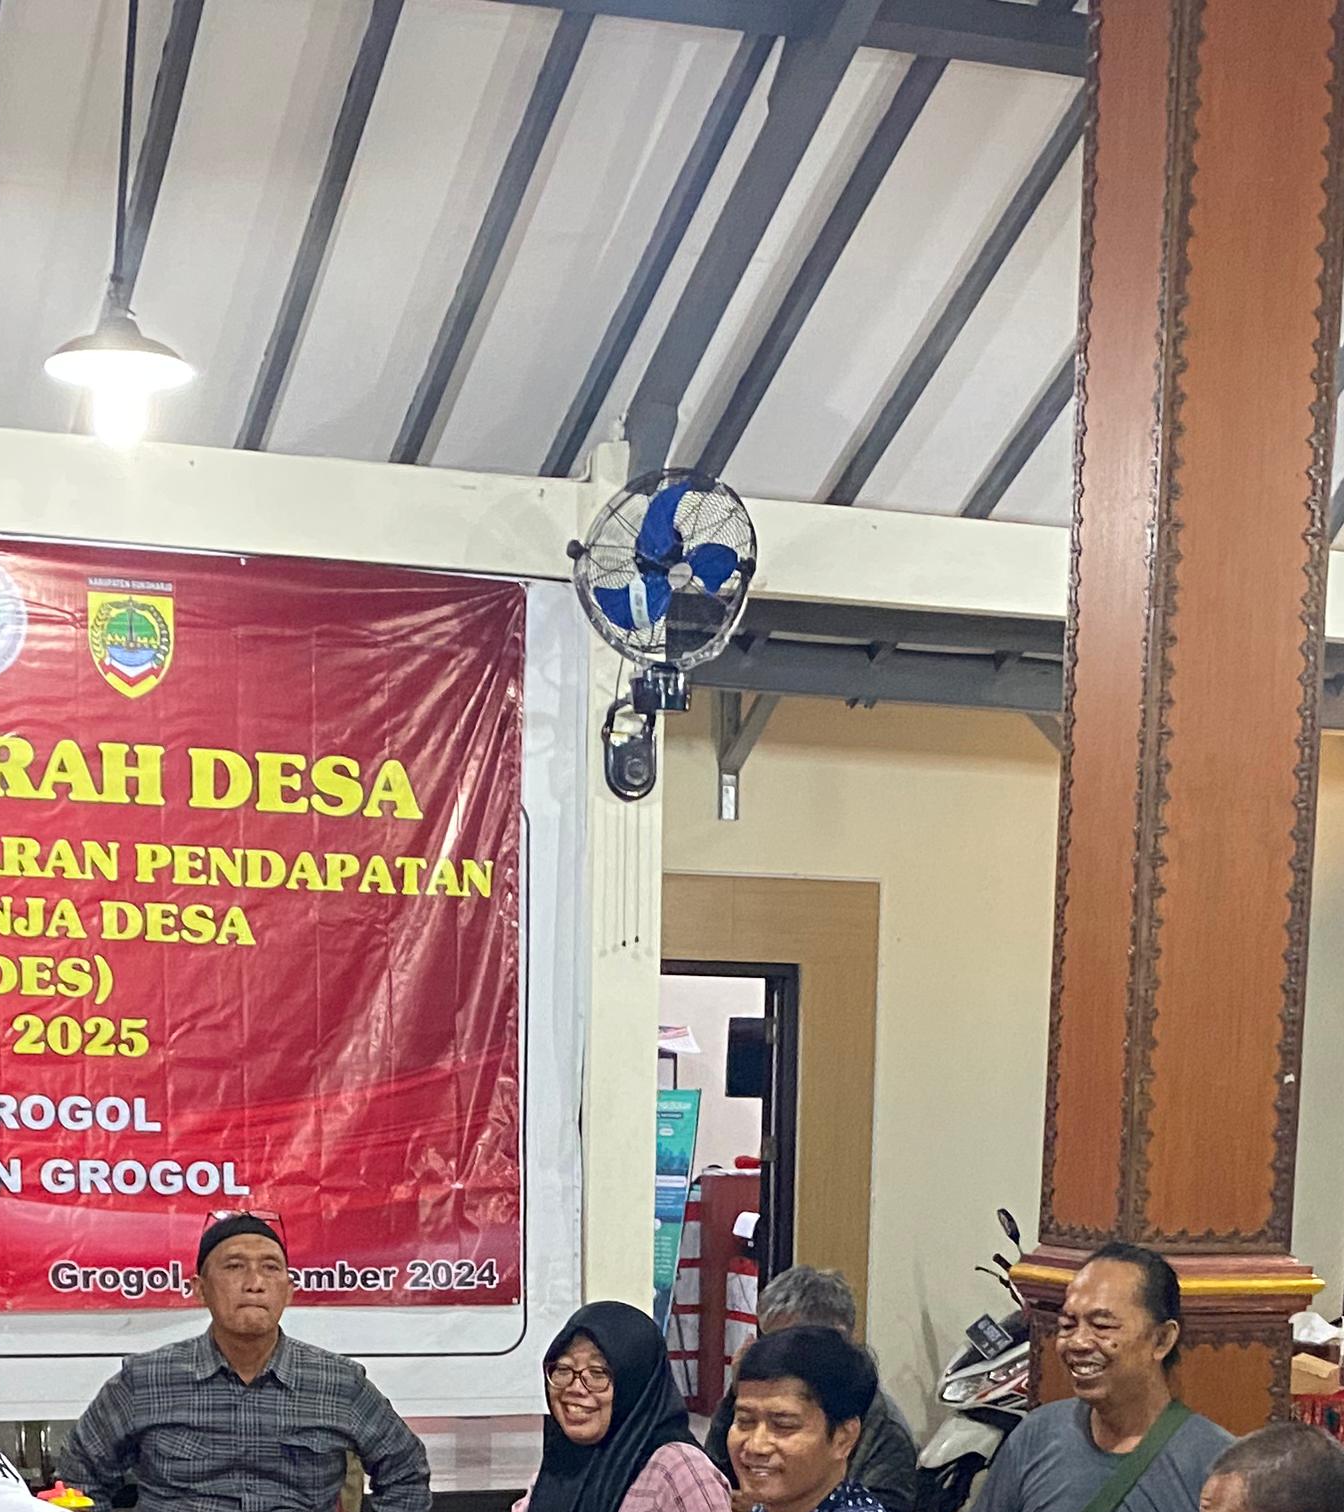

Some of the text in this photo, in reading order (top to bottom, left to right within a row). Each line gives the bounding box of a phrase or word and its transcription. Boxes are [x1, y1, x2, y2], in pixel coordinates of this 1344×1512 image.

[190, 748, 421, 820] DESA
[136, 844, 492, 898] PENDAPATAN
[102, 902, 255, 945] DESA
[14, 1015, 149, 1058] 2025
[40, 1159, 251, 1197] GROGOL
[50, 1258, 500, 1297] Grogol, ember 2024
